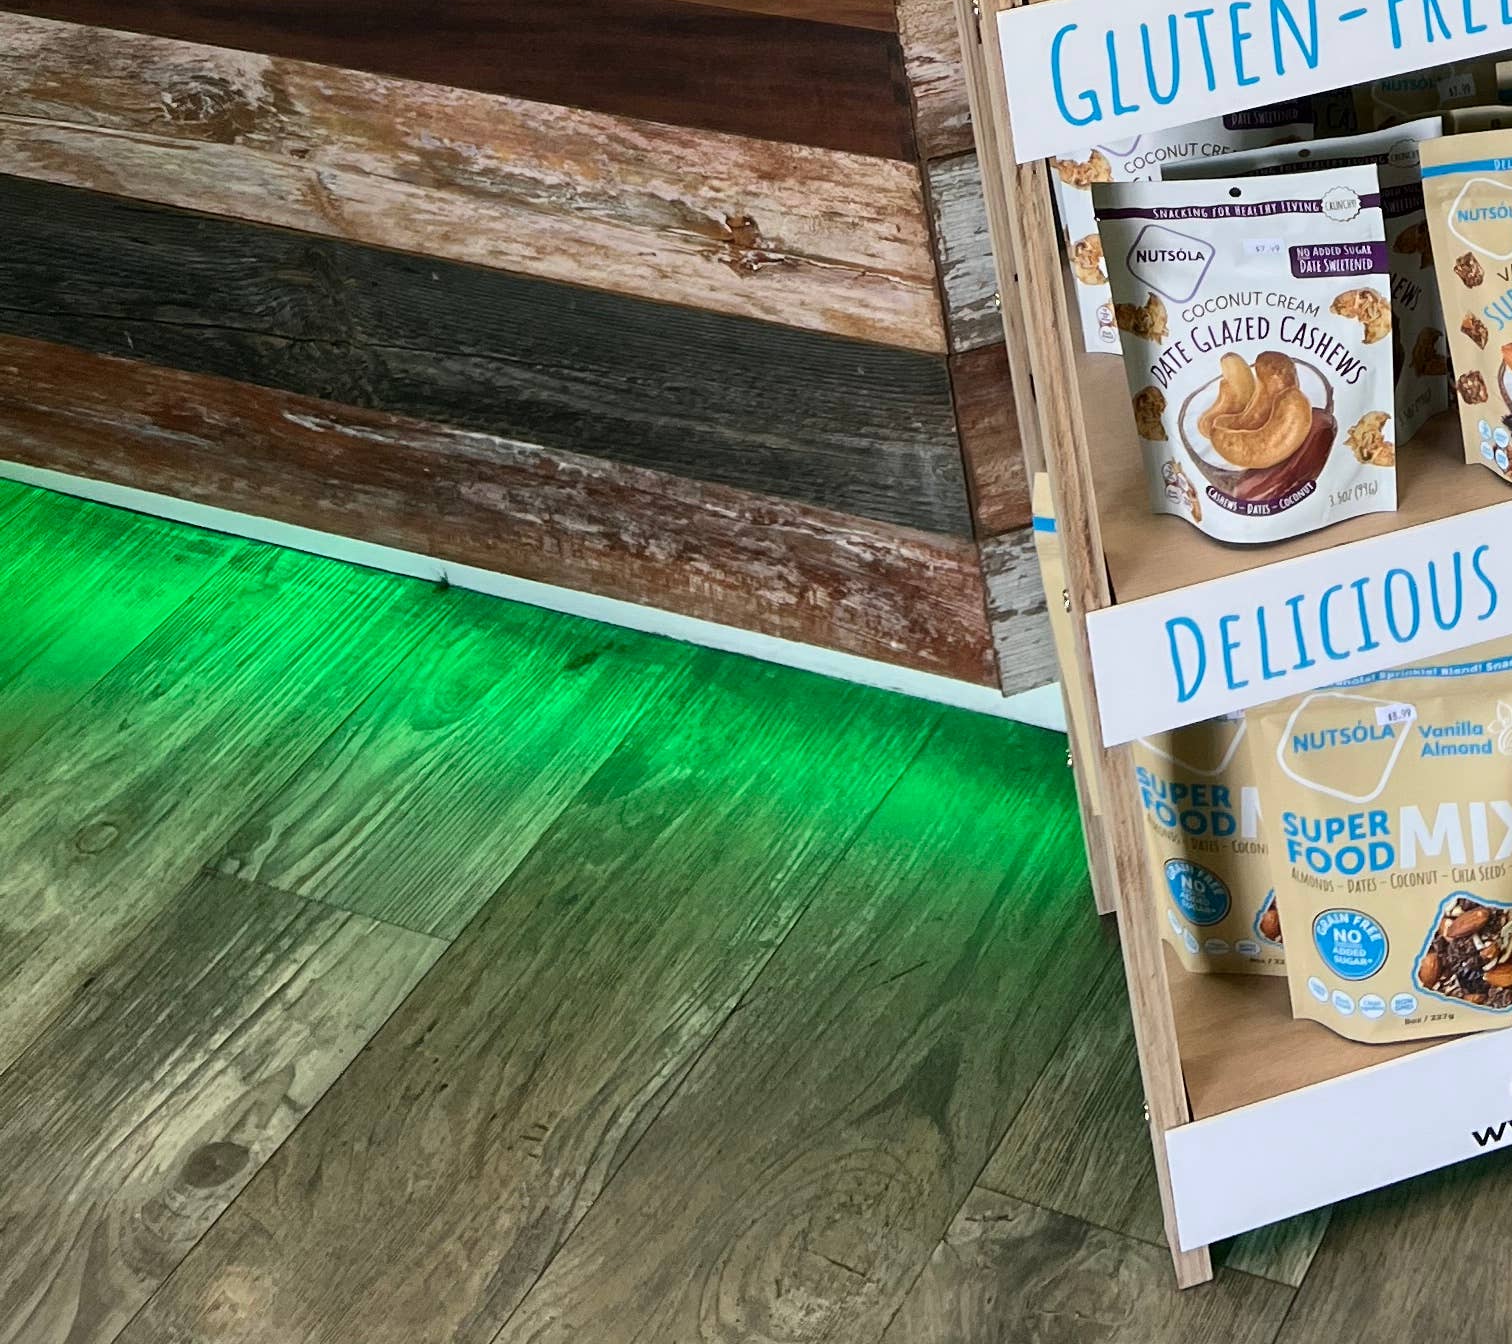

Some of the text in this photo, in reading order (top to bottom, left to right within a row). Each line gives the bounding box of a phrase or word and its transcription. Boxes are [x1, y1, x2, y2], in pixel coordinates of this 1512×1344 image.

[1152, 200, 1319, 220] SNACKING FOR HEALTHY LIVING
[1136, 248, 1205, 263] NUTSÓLA
[1297, 247, 1310, 258] NO
[1312, 246, 1342, 257] ADDED
[1182, 292, 1319, 322] COCONUT CREAM
[1150, 315, 1367, 390] DATE GLAZED CASHEWS
[1293, 721, 1396, 753] NUTSÓLA
[1418, 720, 1484, 739] Vanilla
[1420, 740, 1493, 757] Almond
[1136, 767, 1231, 809] SUPER
[1141, 787, 1236, 836] FOOD
[1282, 810, 1390, 843] SUPER
[1287, 841, 1395, 875] FOOD
[1333, 928, 1362, 944] NO
